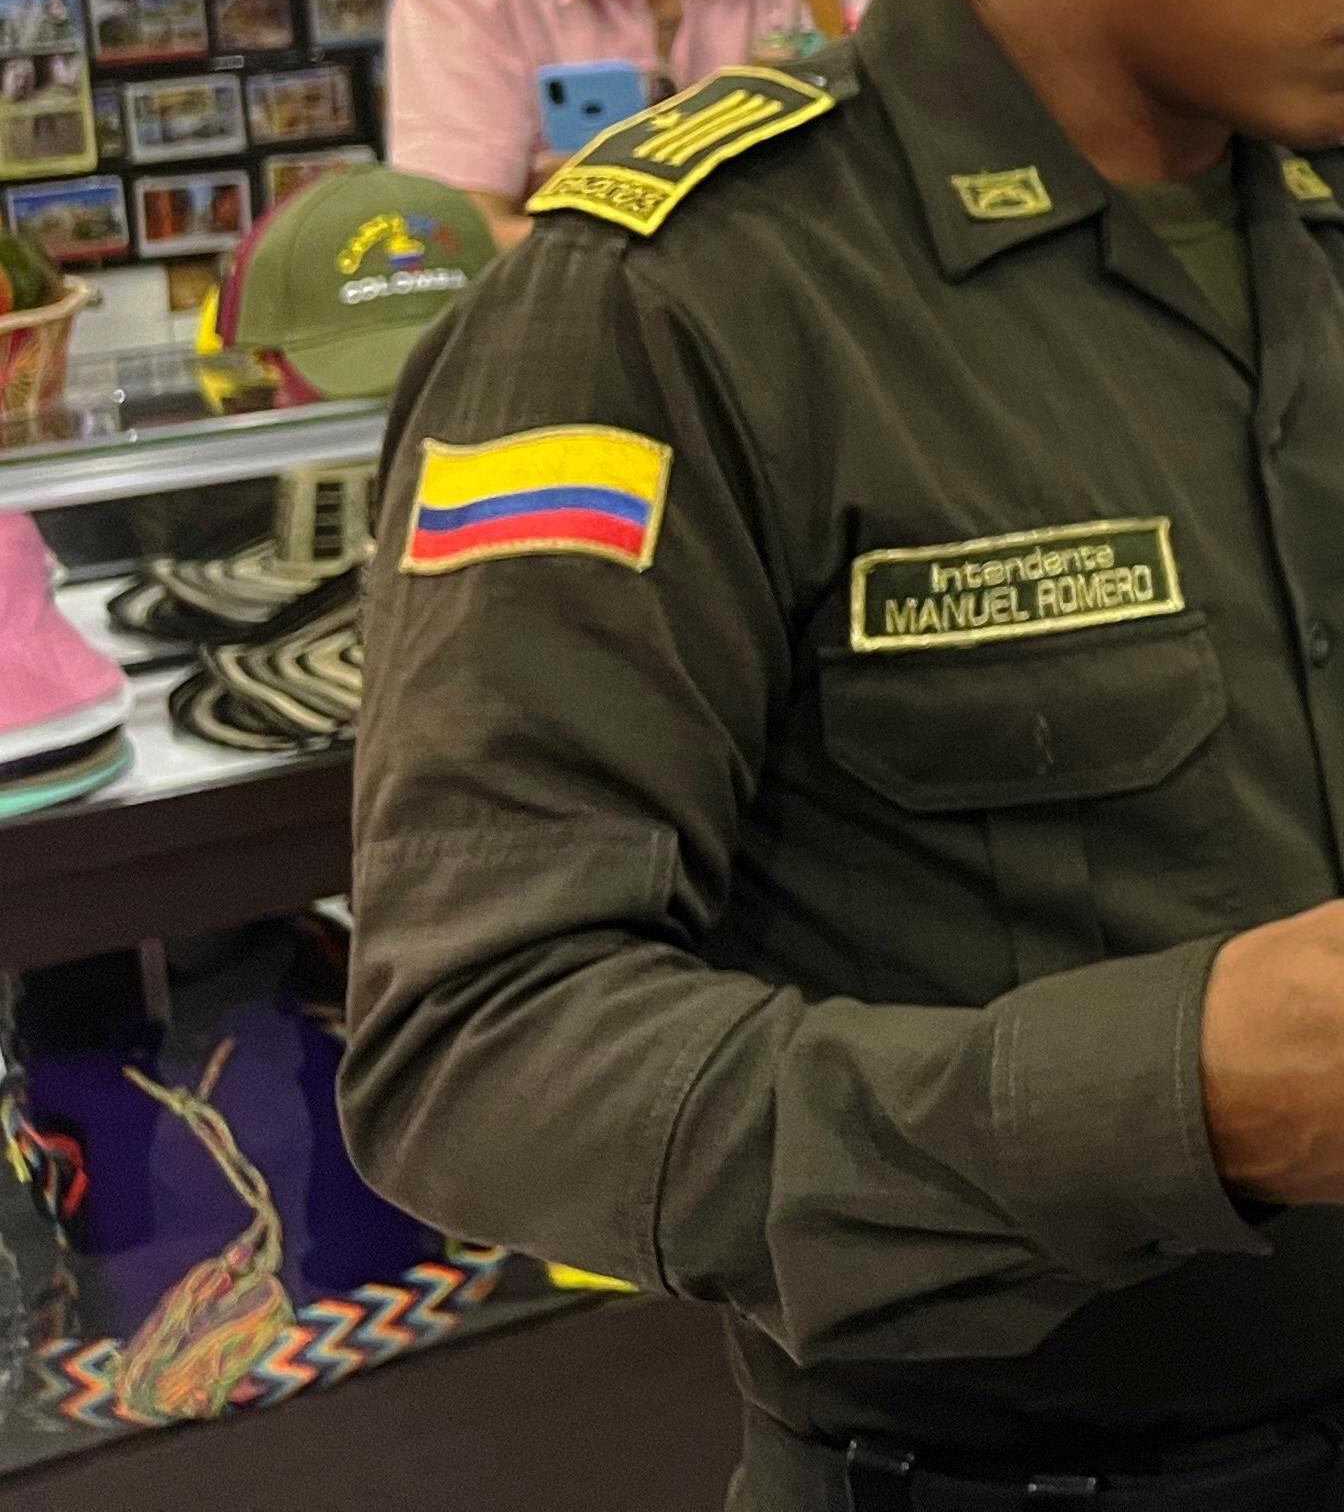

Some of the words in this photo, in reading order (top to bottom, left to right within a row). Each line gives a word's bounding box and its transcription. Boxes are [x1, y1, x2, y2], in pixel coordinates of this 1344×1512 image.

[930, 542, 1115, 594] Intendente
[884, 586, 1031, 634] MANUEL
[1037, 564, 1154, 618] ROMERO
